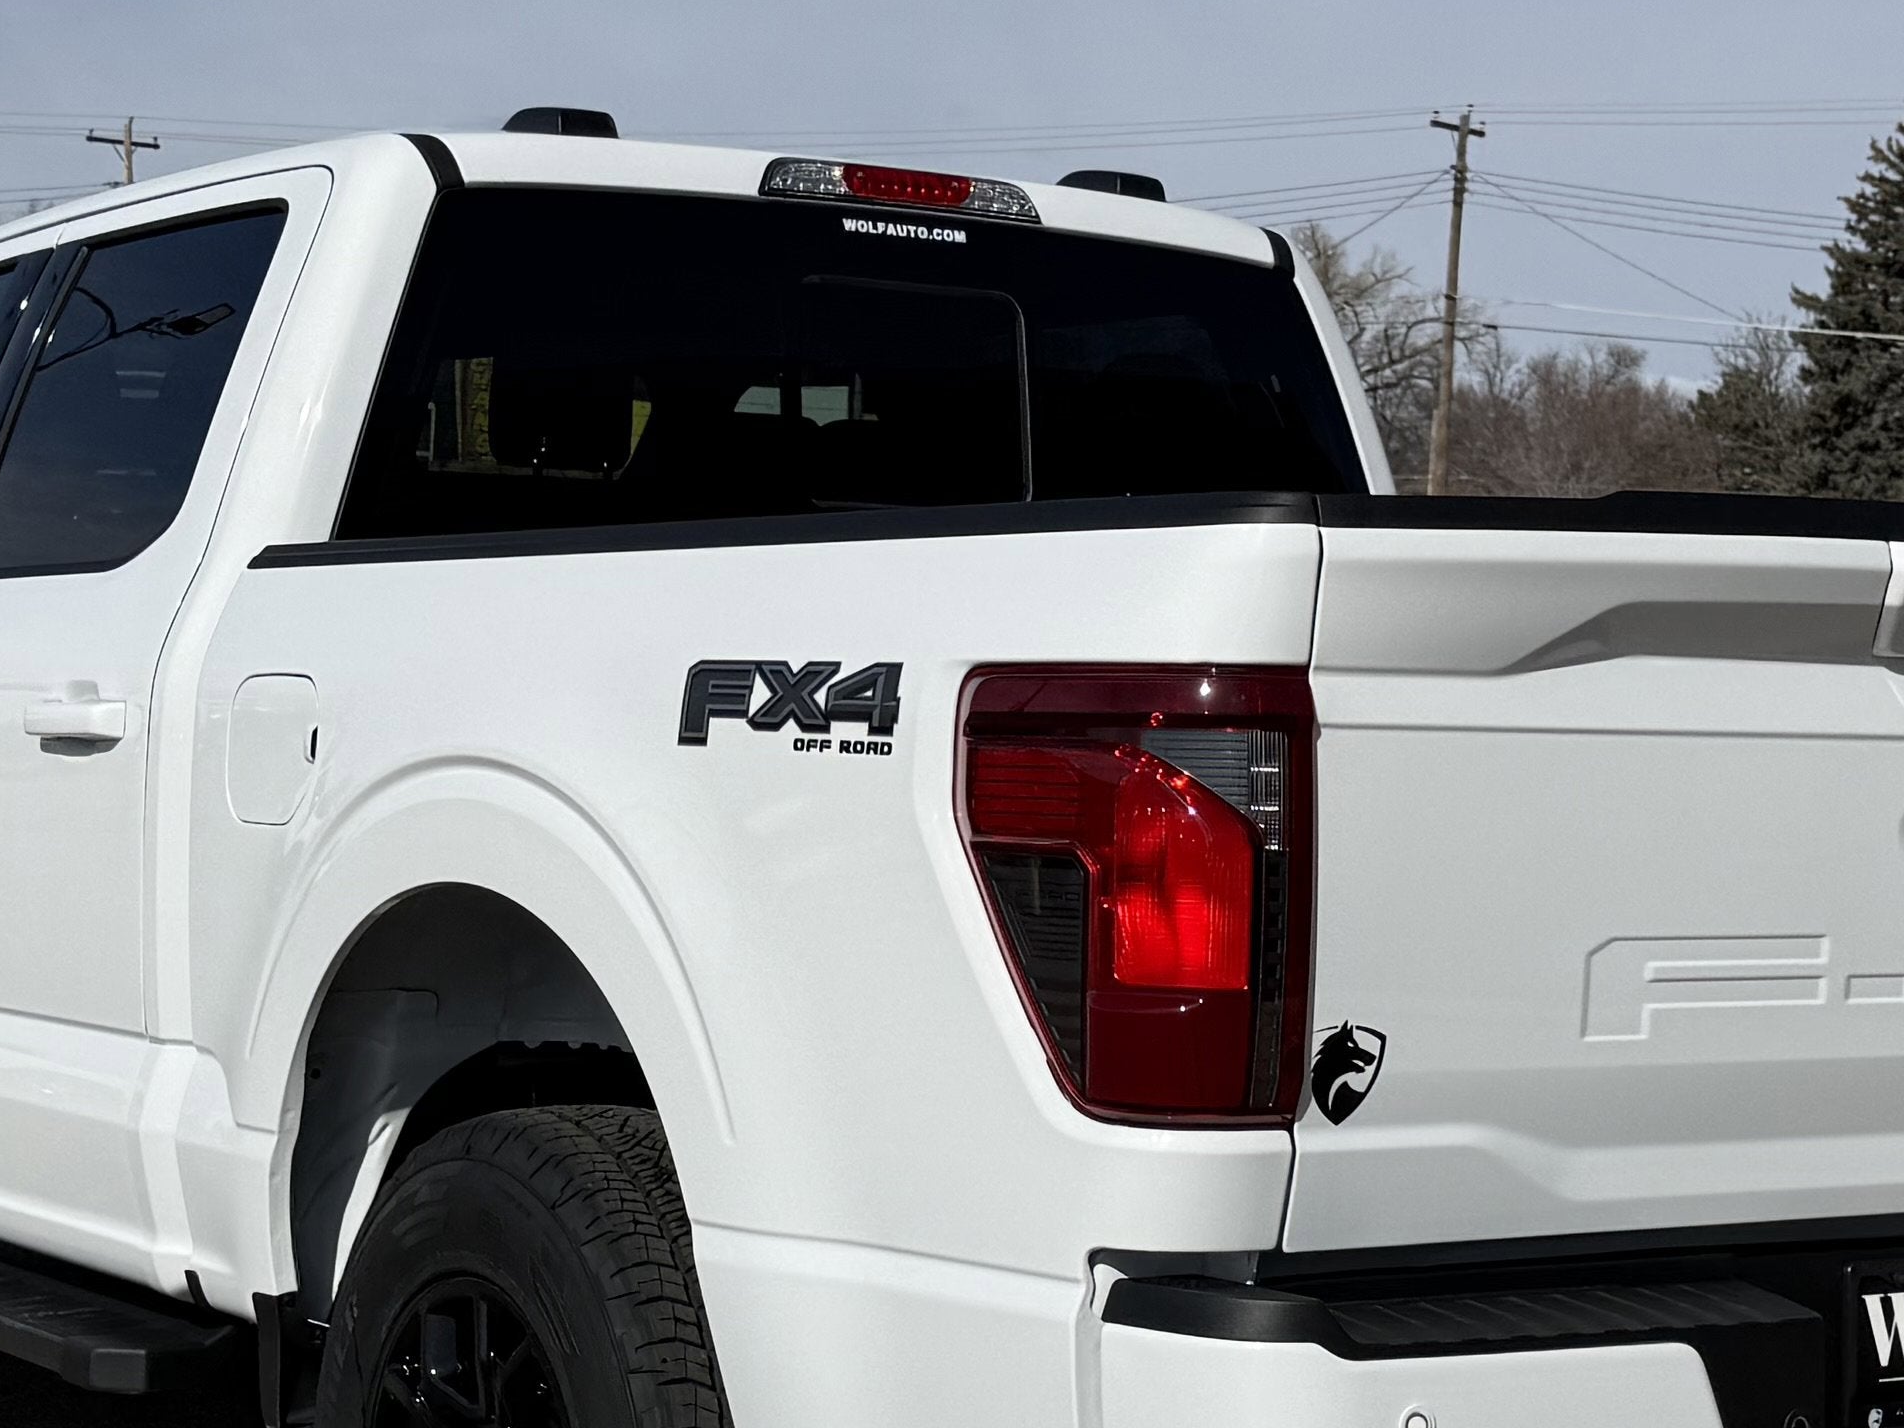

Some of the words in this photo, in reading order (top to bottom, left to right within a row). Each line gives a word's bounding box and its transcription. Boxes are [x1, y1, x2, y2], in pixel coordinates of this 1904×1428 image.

[842, 218, 967, 244] WOLFAUTO.COM
[677, 659, 904, 747] FX4
[792, 737, 832, 753] OFF
[838, 739, 893, 756] ROAD
